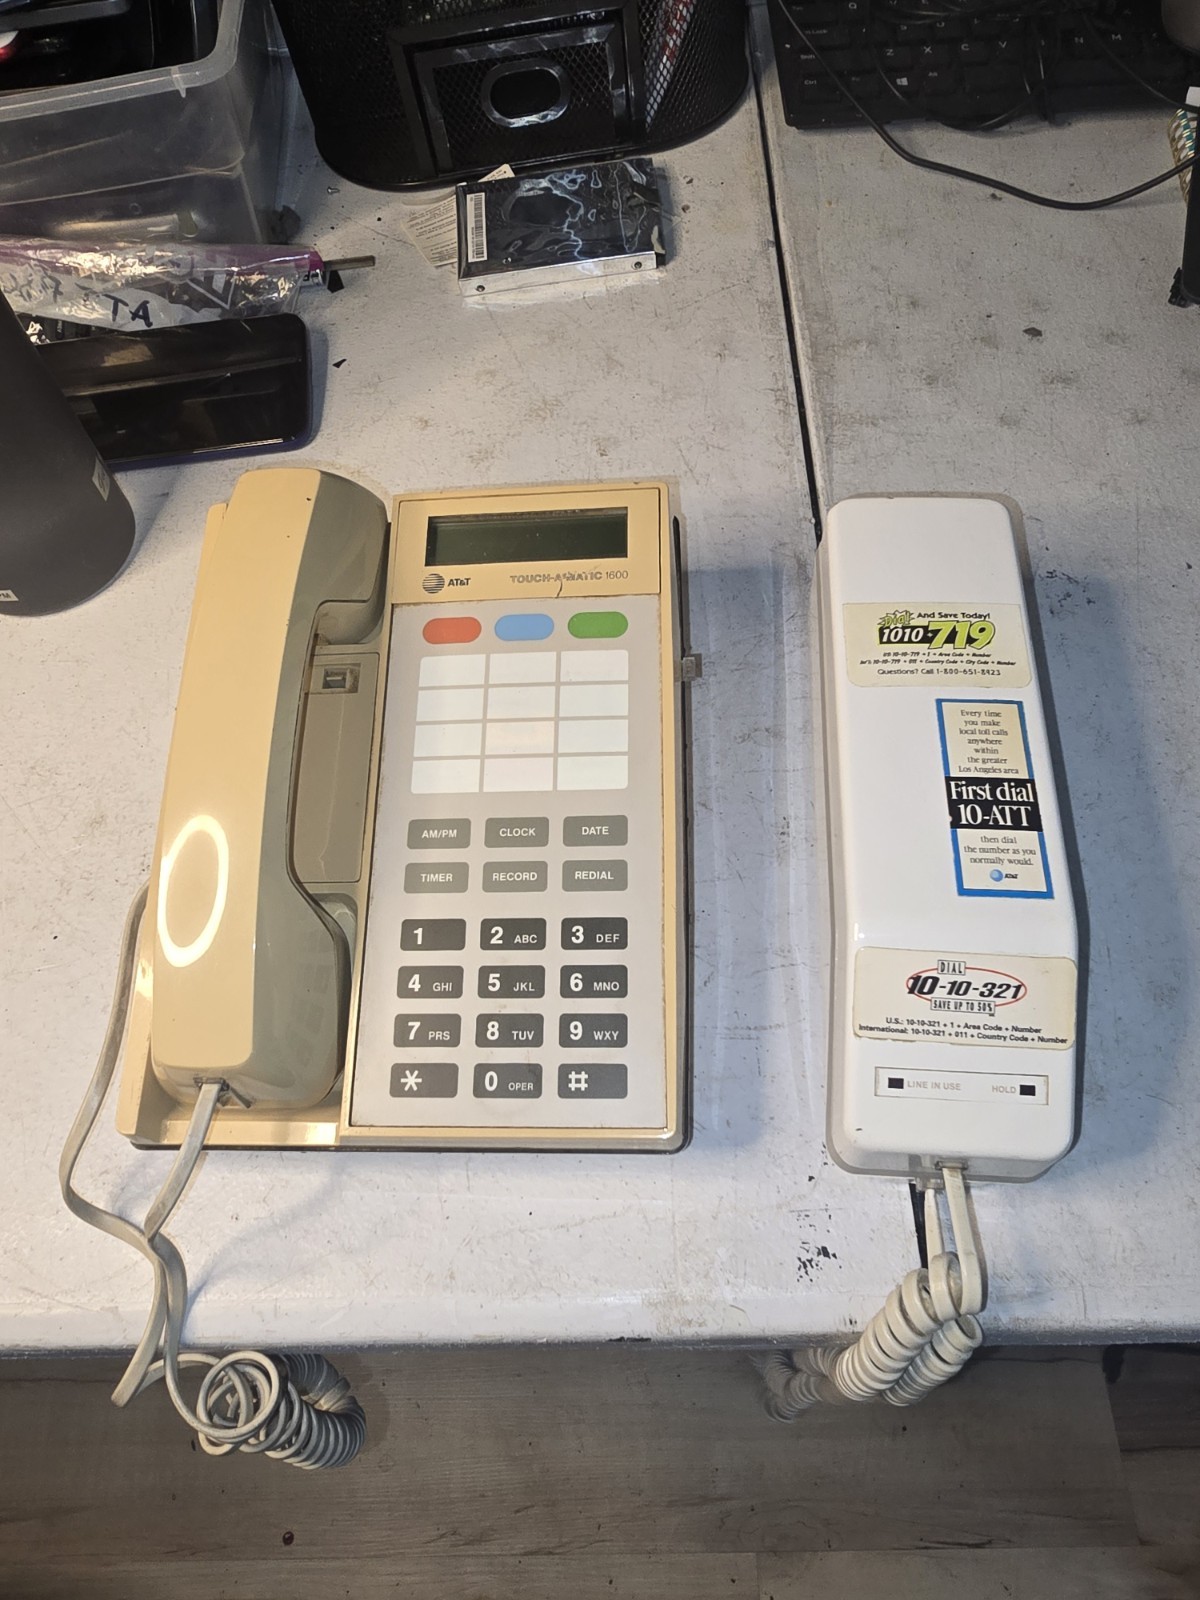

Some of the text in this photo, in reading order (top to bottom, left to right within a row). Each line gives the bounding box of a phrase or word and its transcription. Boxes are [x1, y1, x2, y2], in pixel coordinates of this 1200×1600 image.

[849, 2, 857, 10] Q
[1074, 36, 1084, 44] N
[1111, 33, 1122, 41] M
[885, 48, 895, 56] Z
[923, 46, 932, 54] X
[961, 43, 970, 51] C
[606, 570, 629, 580] 1600
[447, 577, 471, 587] AT&T
[961, 612, 991, 620] Today!
[960, 710, 981, 718] Every
[973, 766, 1002, 774] Angeles
[949, 781, 1034, 802] First dial
[957, 804, 1031, 826] 10-ATT
[421, 829, 457, 839] AM/PM
[499, 828, 536, 837] CLOCK
[582, 826, 609, 835] DATE
[1001, 836, 1017, 844] dial
[964, 845, 977, 853] the
[979, 846, 1010, 854] number
[970, 857, 1034, 866] normally would.
[420, 873, 453, 883] TIMER
[492, 872, 538, 881] RECORD
[575, 871, 614, 880] REDIAL
[413, 927, 423, 945] 1
[490, 926, 537, 944] 2 ABC
[571, 925, 620, 944] 3 DEF
[940, 961, 963, 974] DIAL
[408, 974, 452, 992] 4 GHI
[487, 973, 535, 992] 5 JKL
[570, 972, 620, 992] 6 MNO
[907, 975, 1022, 999] 10-10-321
[933, 1000, 951, 1009] SAVE
[954, 1001, 963, 1010] UP
[966, 1001, 974, 1011] TO
[906, 1018, 940, 1027] 10-10-321
[1011, 1025, 1042, 1033] Number
[407, 1021, 450, 1041] 7 PRS
[486, 1021, 534, 1041] 8 TUV
[569, 1021, 619, 1041] 9 WXY
[859, 1024, 908, 1034] International:
[911, 1028, 945, 1037] 10-10-321
[977, 1032, 1007, 1041] Country
[1009, 1034, 1029, 1042] Code
[1037, 1036, 1068, 1044] Number
[485, 1071, 534, 1091] 0 OPER
[568, 1071, 588, 1091] #
[907, 1080, 962, 1091] LINE IN USE
[992, 1085, 1017, 1094] HOLD
